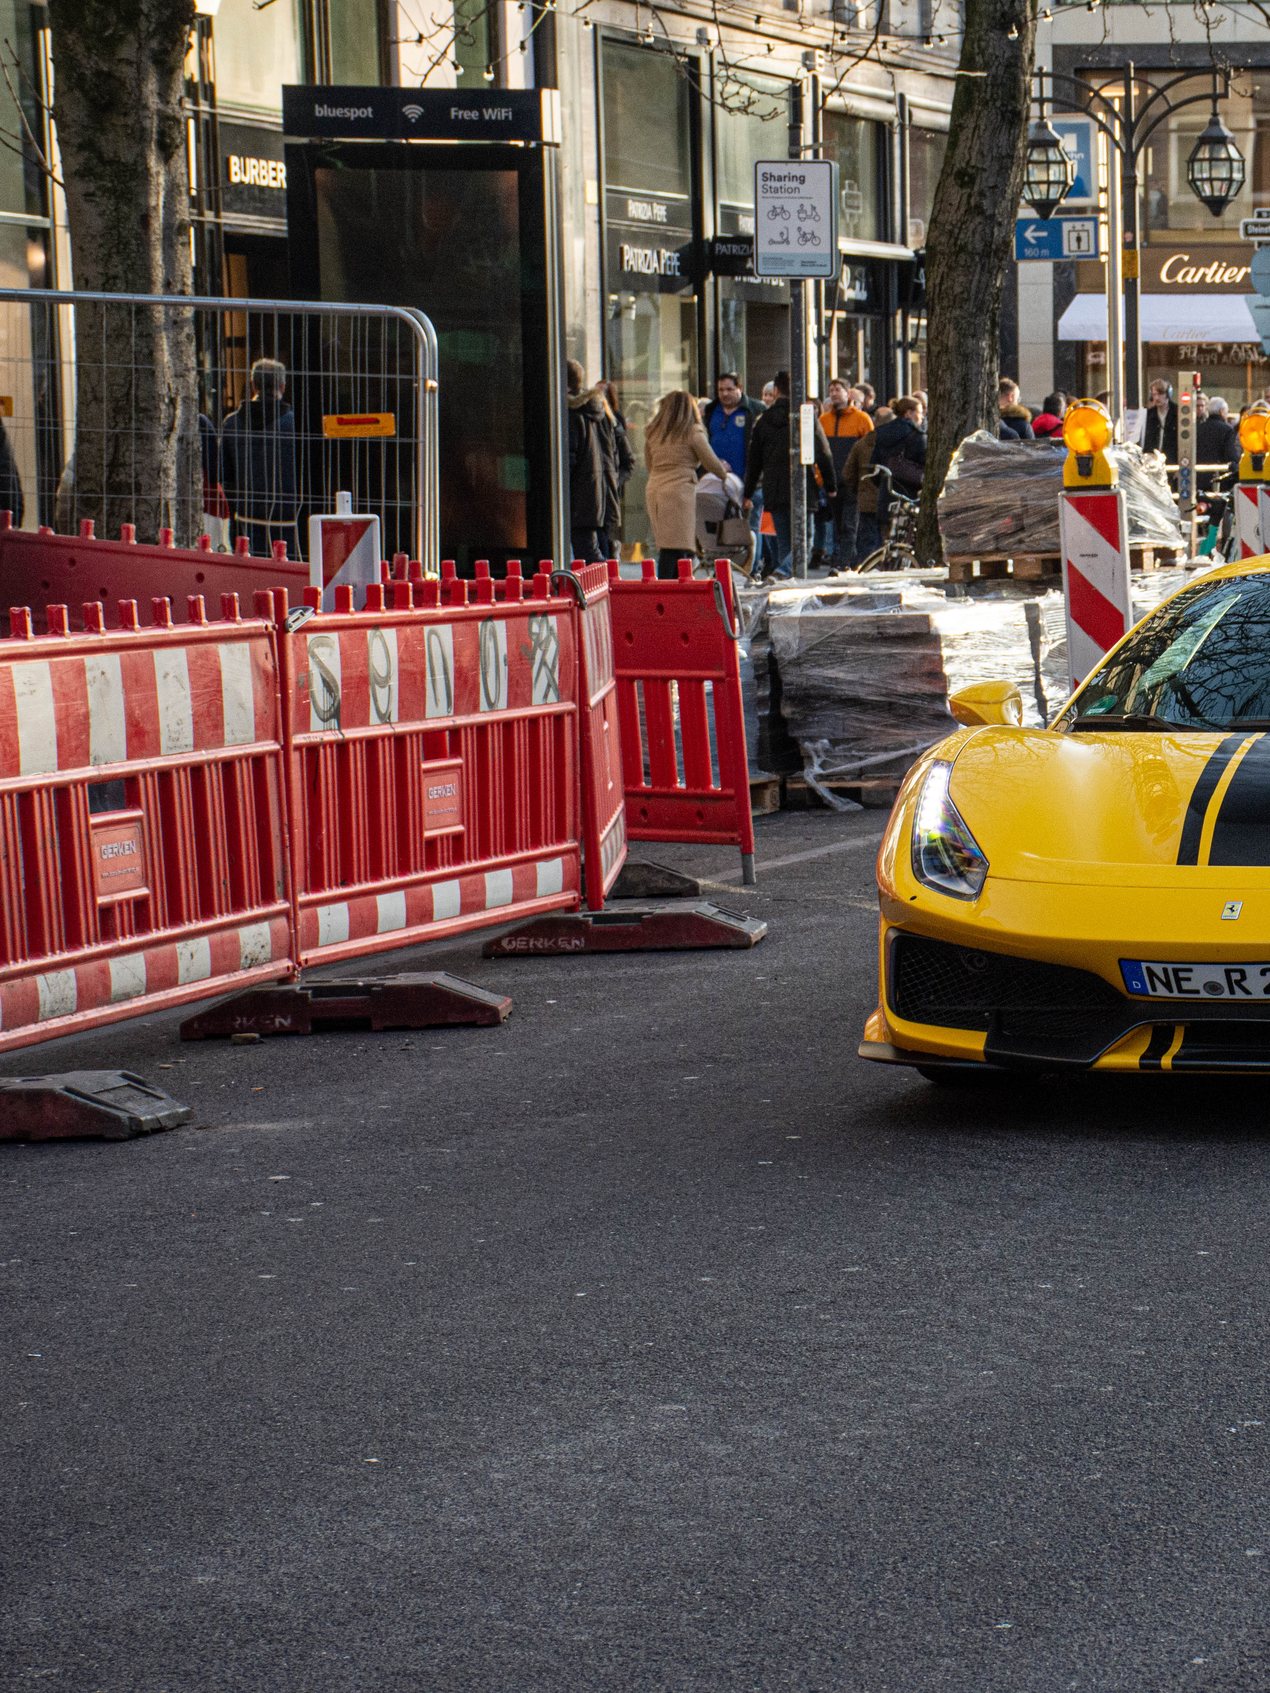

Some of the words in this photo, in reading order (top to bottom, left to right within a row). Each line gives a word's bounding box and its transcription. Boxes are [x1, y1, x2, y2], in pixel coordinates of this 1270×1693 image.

[314, 104, 374, 119] bluespot
[450, 107, 479, 121] Free
[483, 107, 513, 121] WiFi
[761, 172, 806, 185] Sharing
[761, 184, 801, 195] Station
[623, 244, 660, 274] PATRIZIA
[661, 248, 681, 276] PEPE
[1159, 253, 1252, 285] Cartier
[1162, 326, 1210, 340] Cartier
[428, 783, 456, 800] GERKEN
[101, 839, 137, 860] GERKEN
[501, 937, 586, 951] GERKEN
[1145, 966, 1200, 994] NE
[1224, 968, 1252, 995] R
